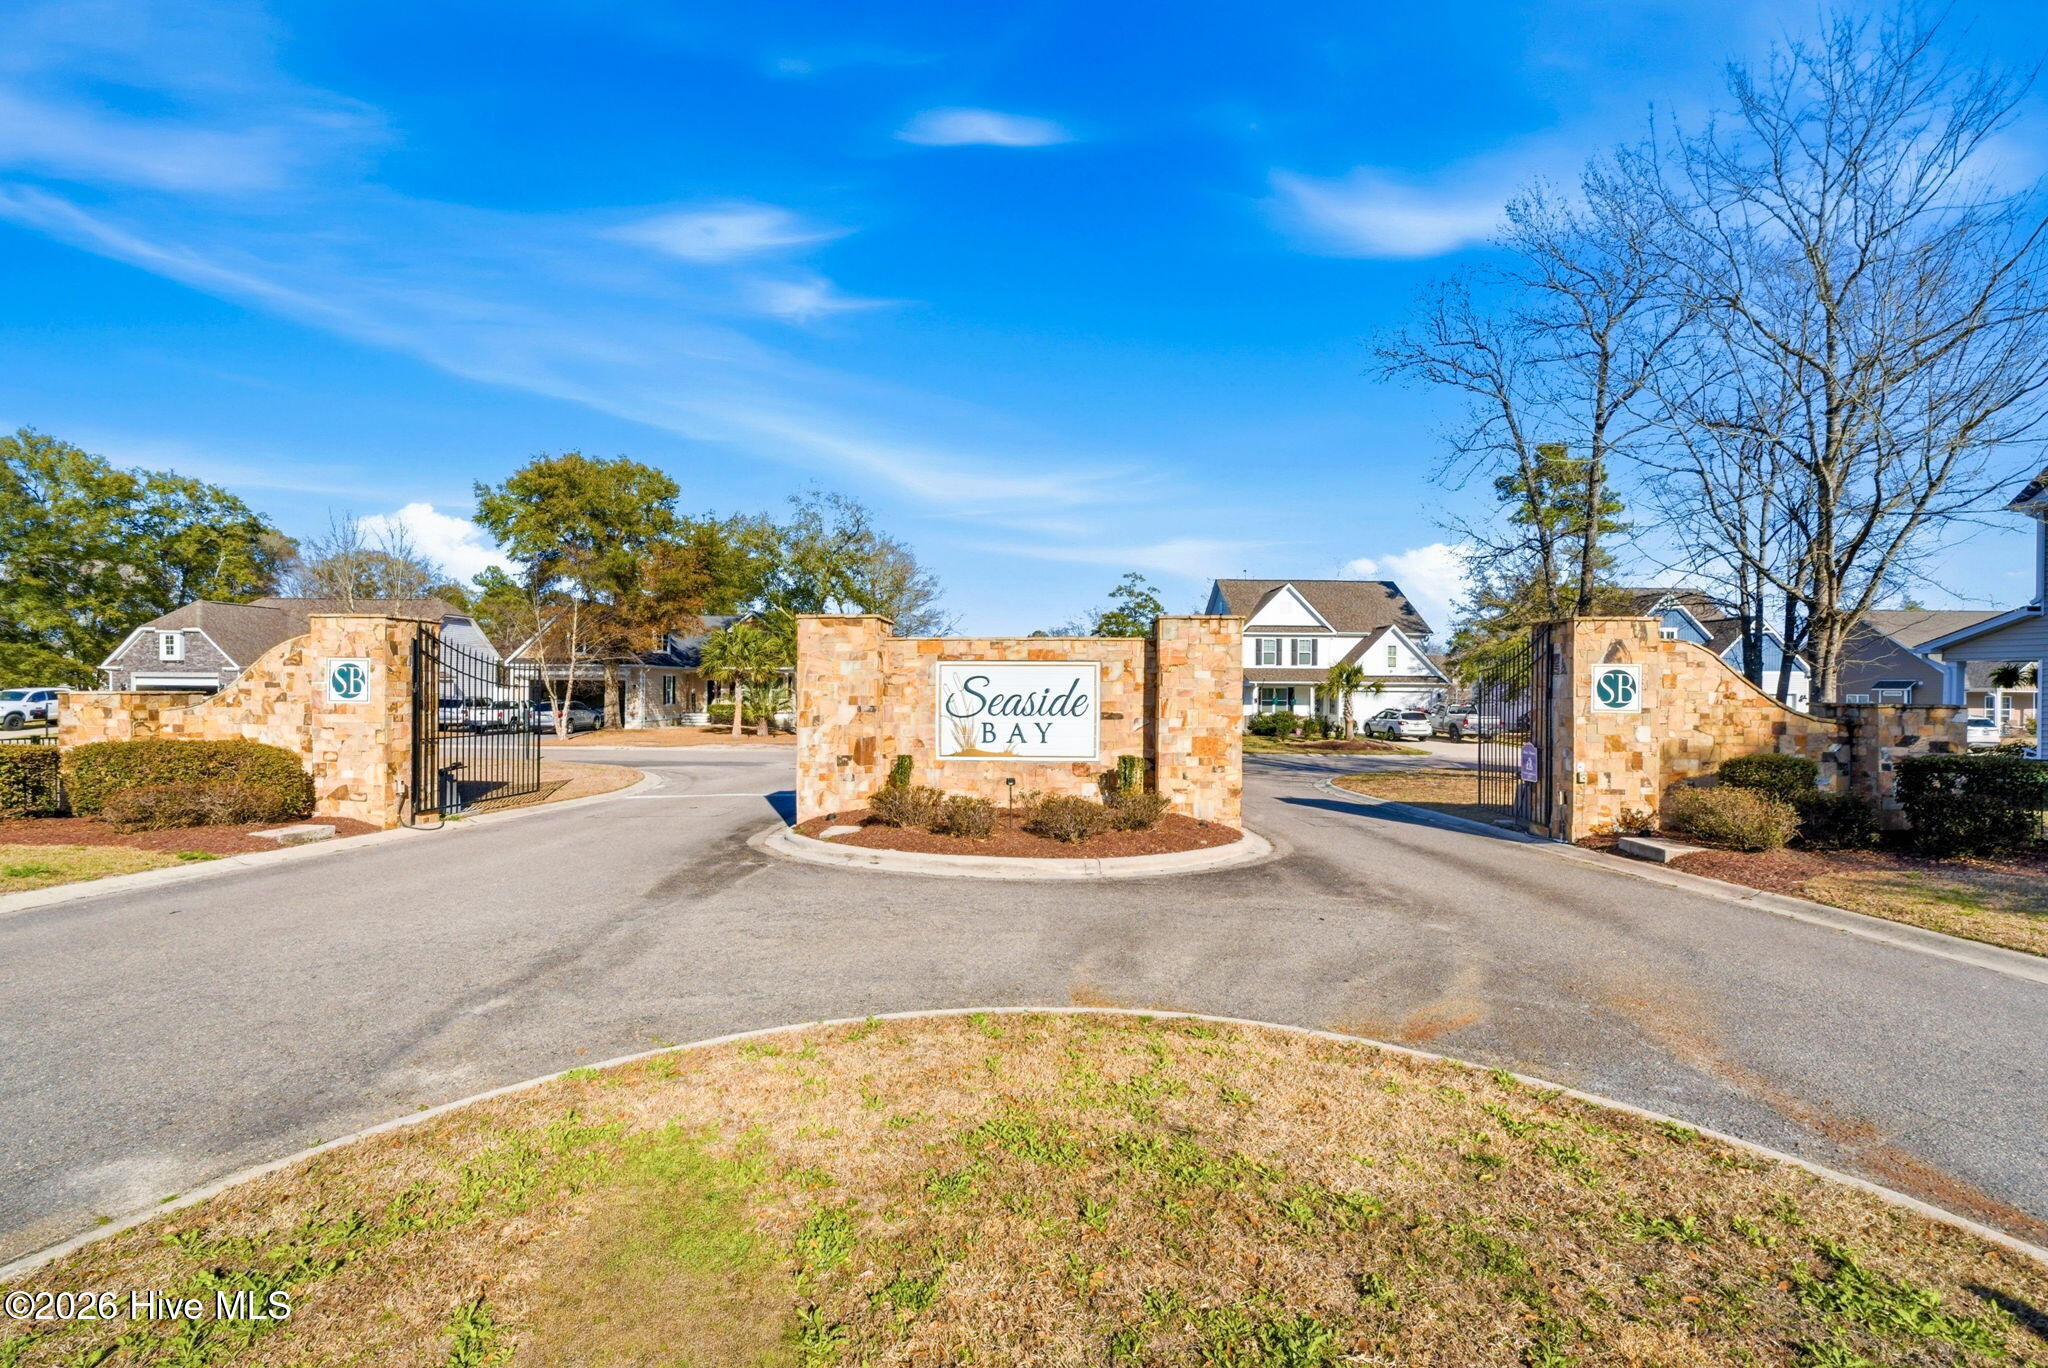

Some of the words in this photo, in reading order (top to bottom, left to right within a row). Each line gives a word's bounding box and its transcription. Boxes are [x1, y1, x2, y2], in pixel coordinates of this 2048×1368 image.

[333, 666, 365, 695] SB
[1598, 673, 1636, 704] SB
[945, 675, 1089, 718] Seaside
[981, 722, 1054, 744] BAY
